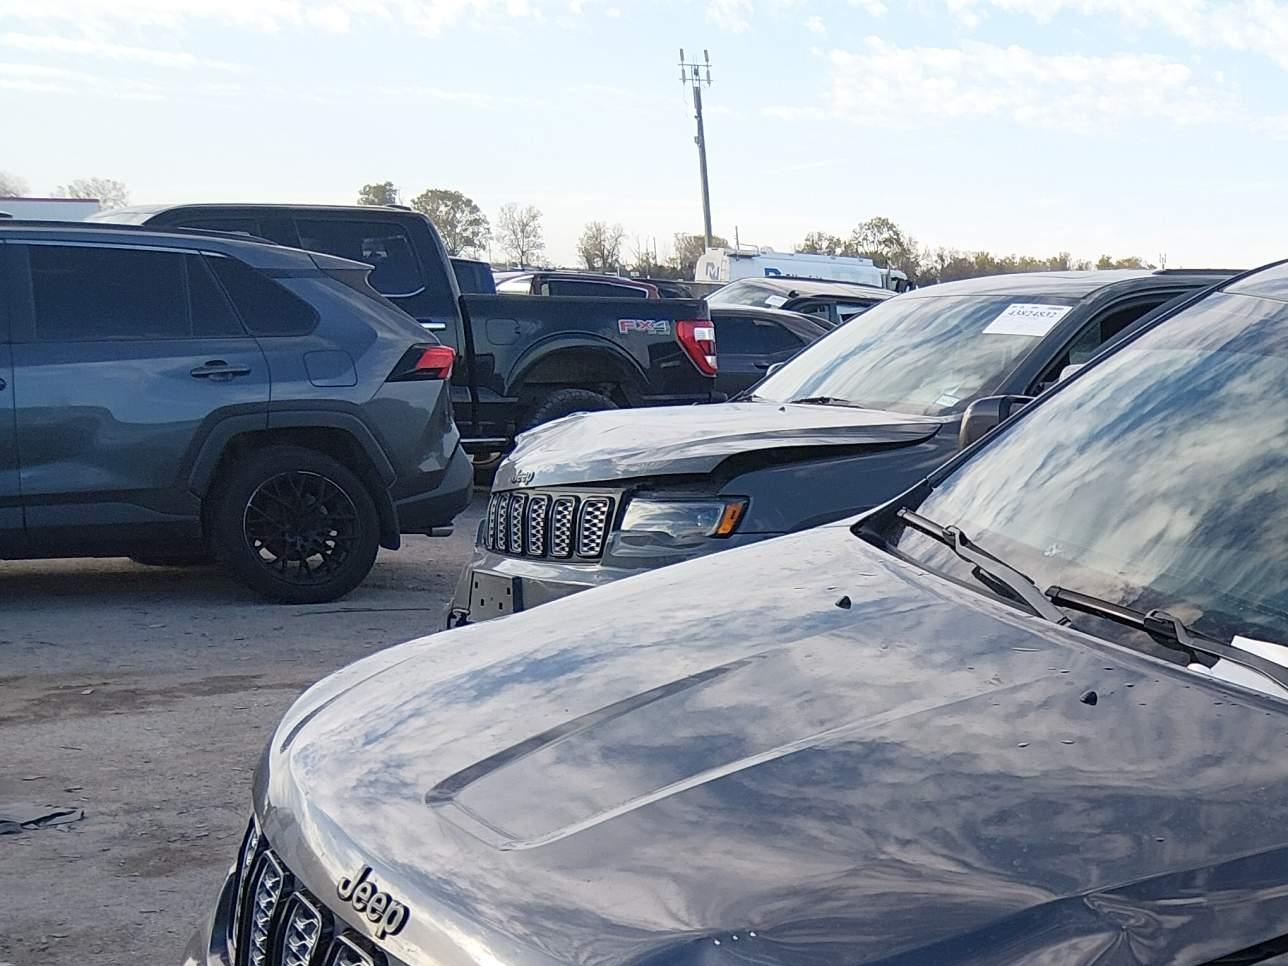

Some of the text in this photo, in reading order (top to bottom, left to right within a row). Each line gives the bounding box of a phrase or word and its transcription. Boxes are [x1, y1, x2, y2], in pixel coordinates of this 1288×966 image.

[618, 319, 670, 335] FX4
[511, 469, 535, 486] Jeep
[337, 864, 411, 940] Jeep
